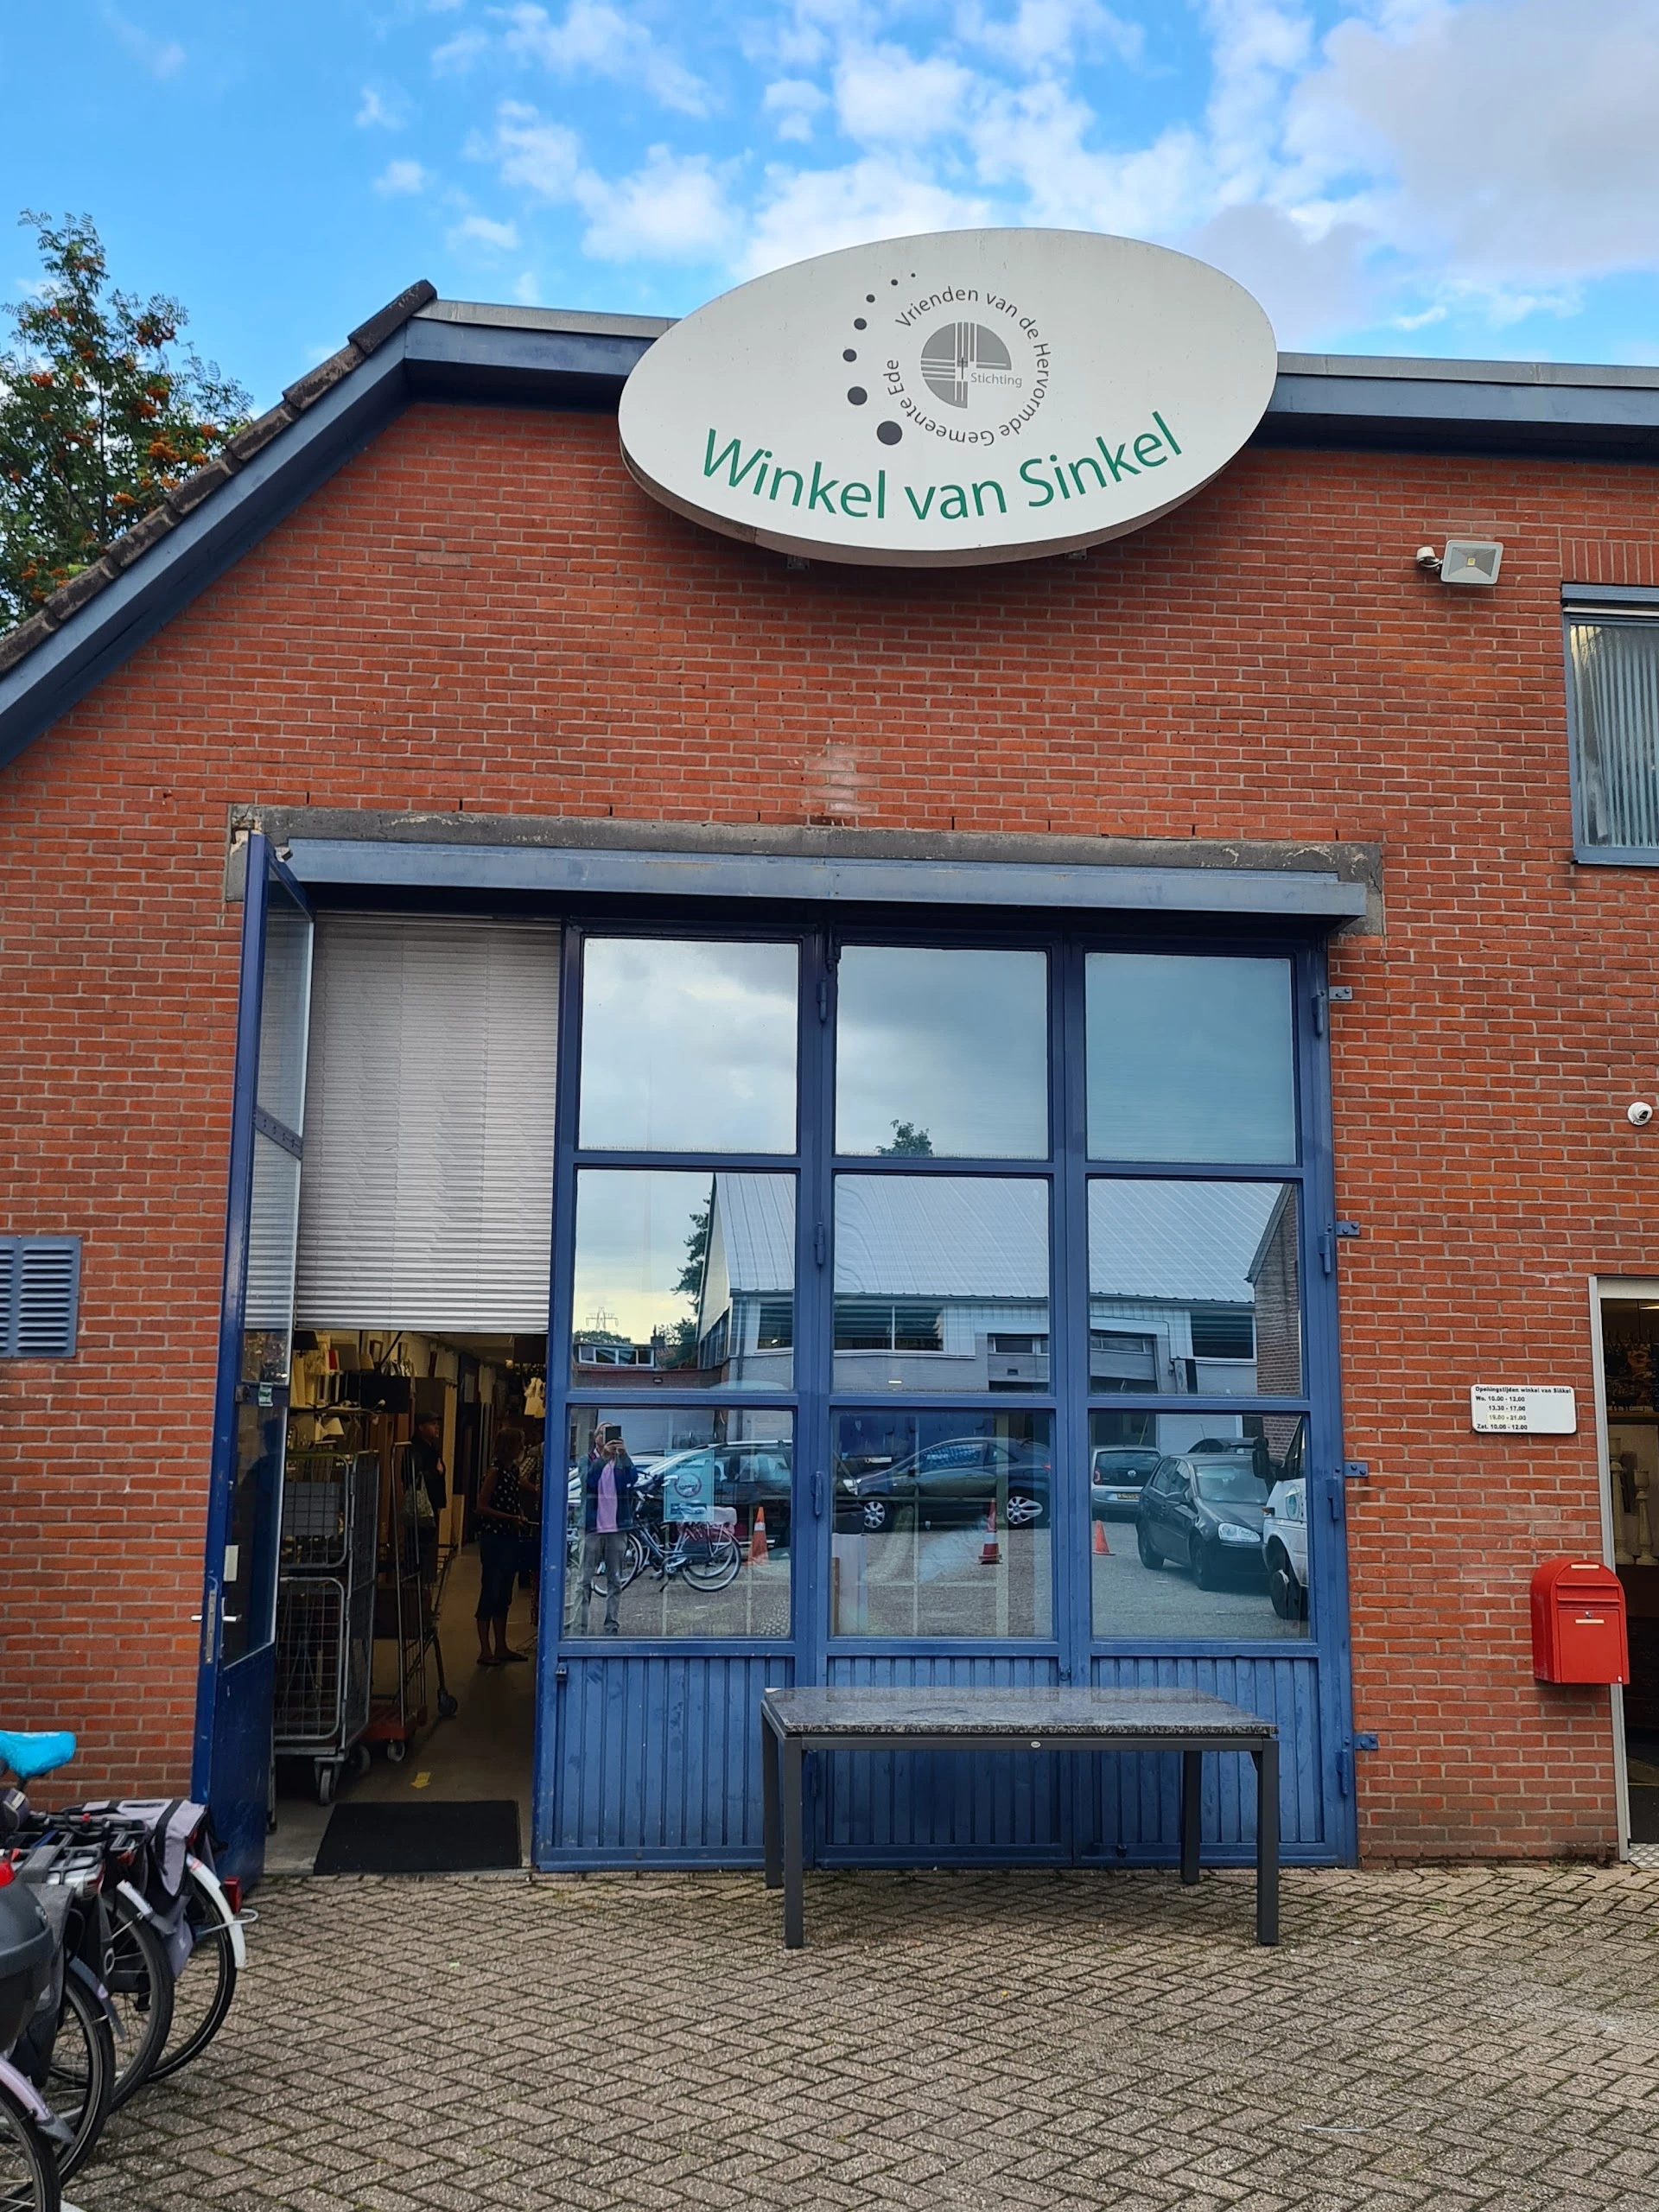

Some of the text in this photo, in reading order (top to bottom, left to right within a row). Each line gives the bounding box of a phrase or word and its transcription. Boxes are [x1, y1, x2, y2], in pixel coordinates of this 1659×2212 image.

[882, 285, 1052, 447] Vrienden van de Hervormde Gemeente Ede
[970, 372, 1023, 388] Stichting
[702, 411, 1183, 520] Winkel van Sinkel
